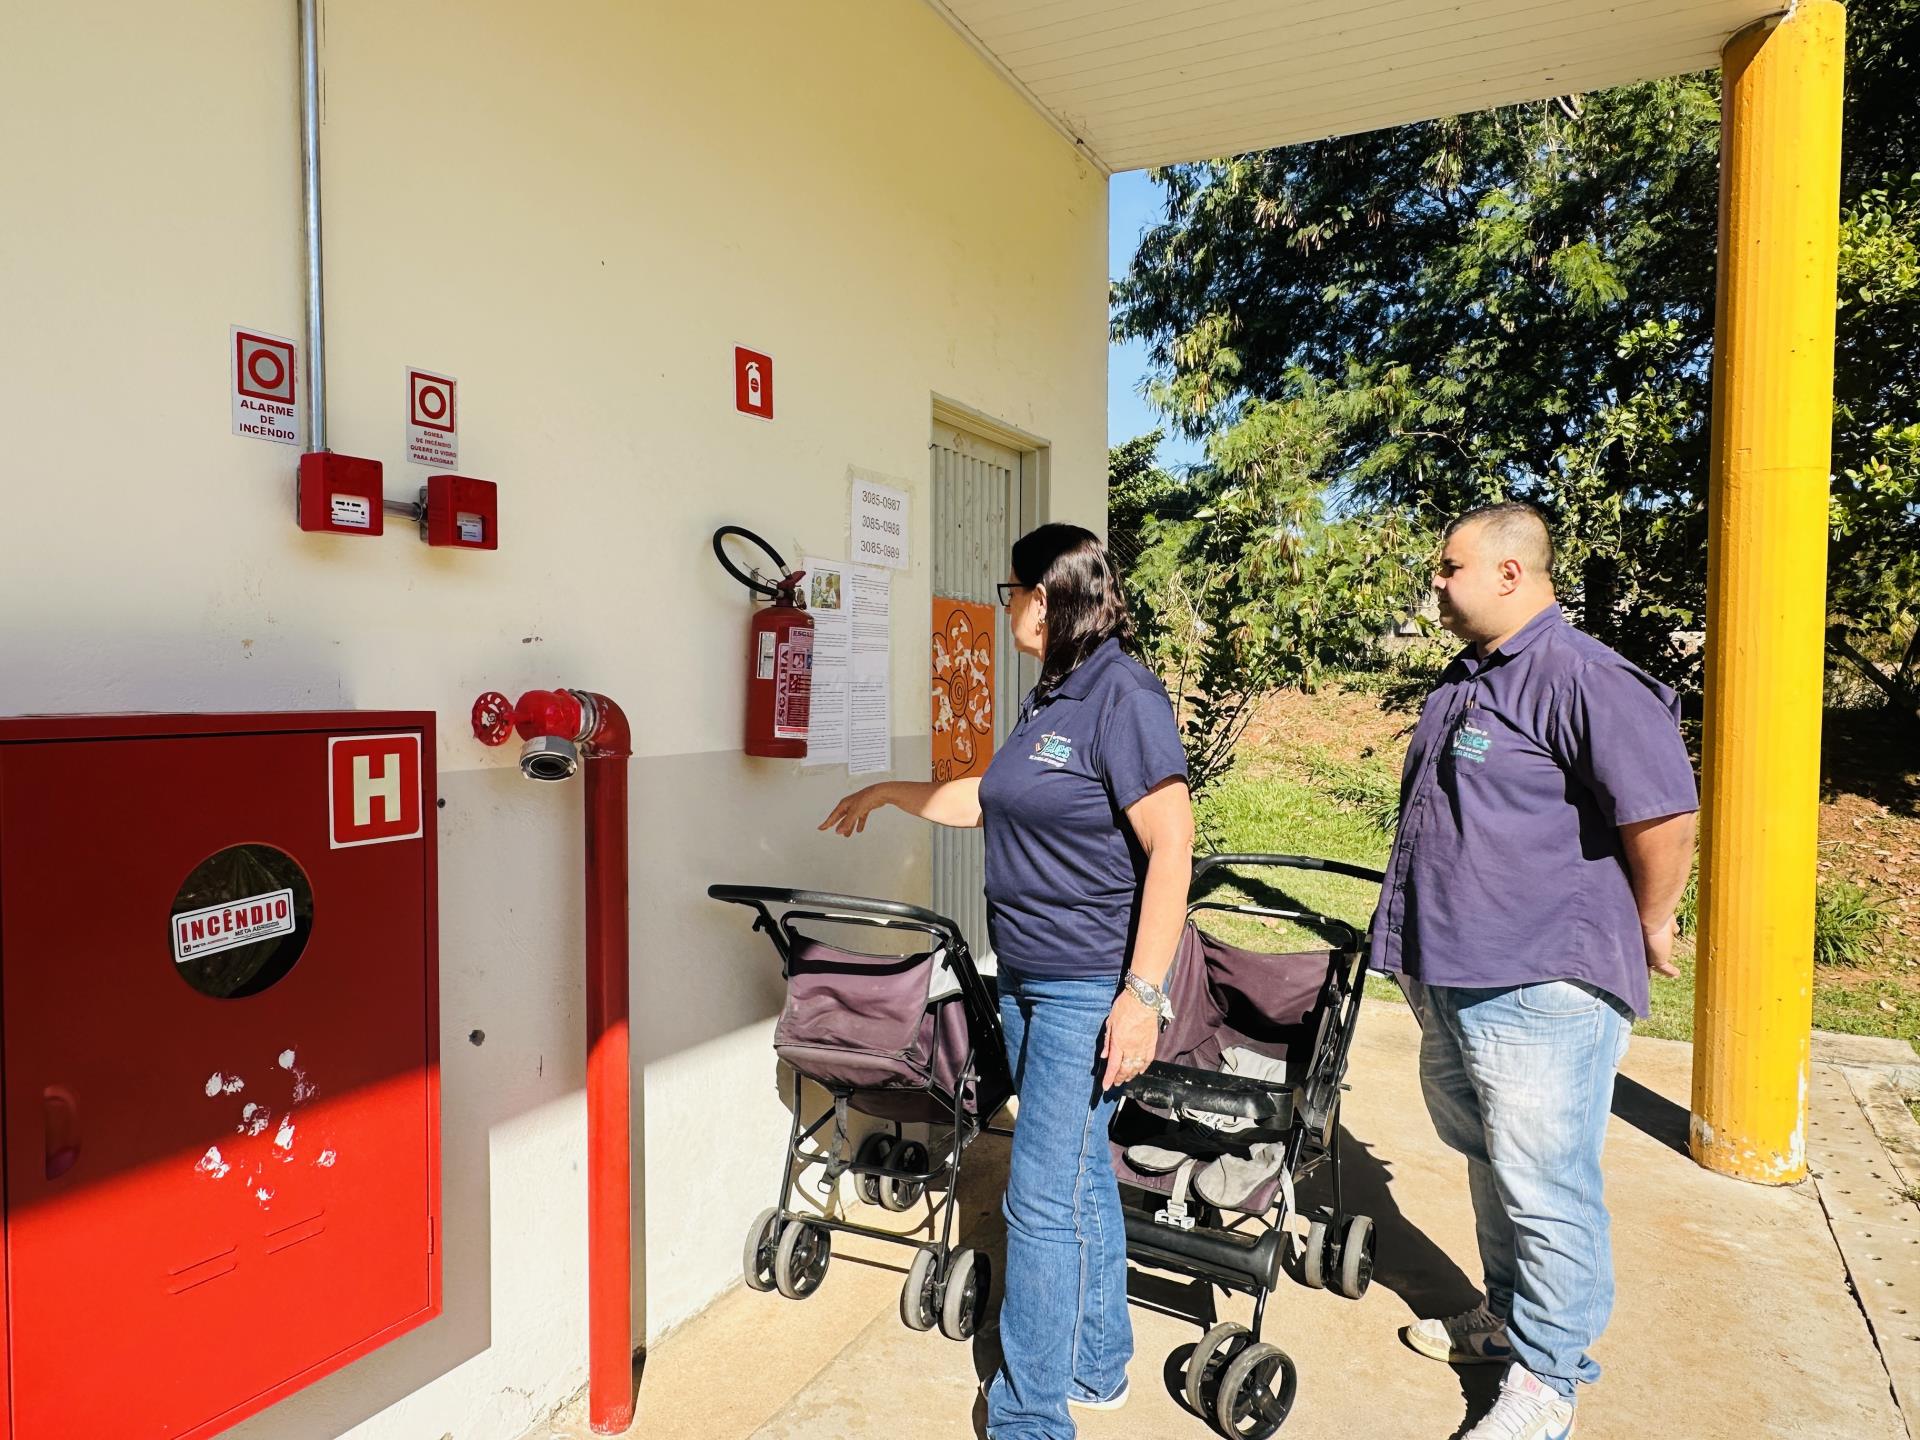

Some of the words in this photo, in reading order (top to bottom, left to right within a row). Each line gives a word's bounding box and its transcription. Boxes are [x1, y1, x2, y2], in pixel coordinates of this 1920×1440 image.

[240, 399, 294, 417] ALARME
[260, 415, 275, 425] DE
[424, 430, 443, 439] BOMBA
[410, 444, 433, 454] QUEBRE
[413, 453, 429, 461] PARA
[862, 490, 901, 511] 3085-0987
[860, 540, 900, 559] 3085-0989
[353, 753, 401, 826] H
[181, 899, 287, 944] INCÊNDIO
